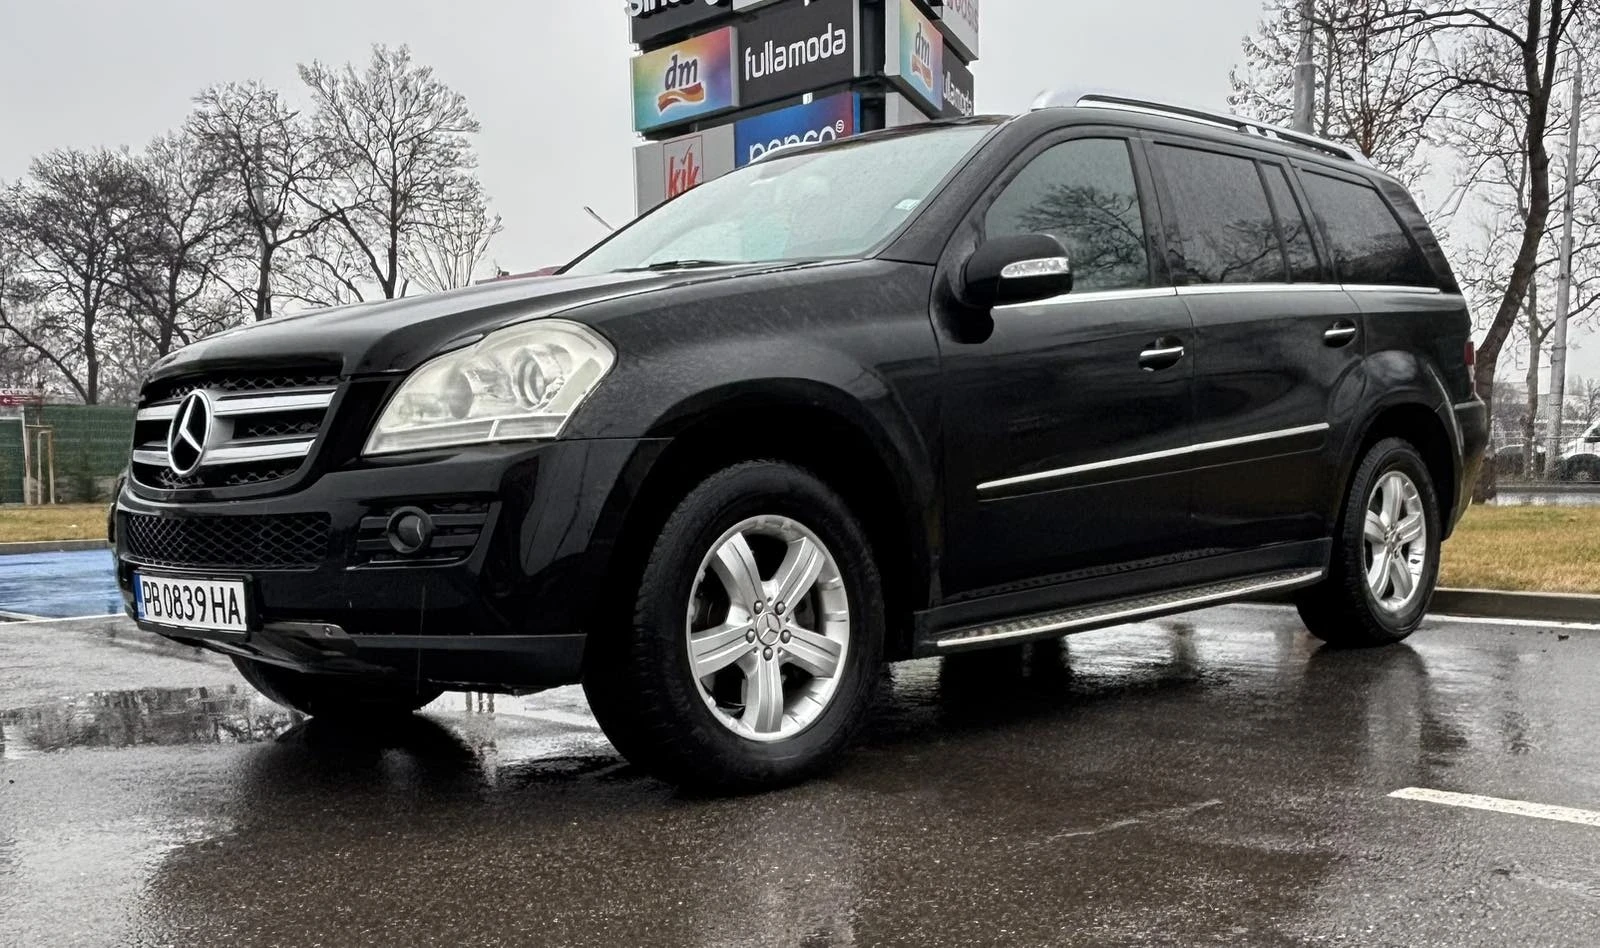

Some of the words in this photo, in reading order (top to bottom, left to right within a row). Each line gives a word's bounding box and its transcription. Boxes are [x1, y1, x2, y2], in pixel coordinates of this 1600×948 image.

[745, 22, 846, 81] fullamoda
[915, 22, 930, 67] dm
[665, 54, 698, 90] dm
[143, 580, 162, 617] PB
[163, 583, 206, 622] 0839
[210, 586, 242, 625] HA
